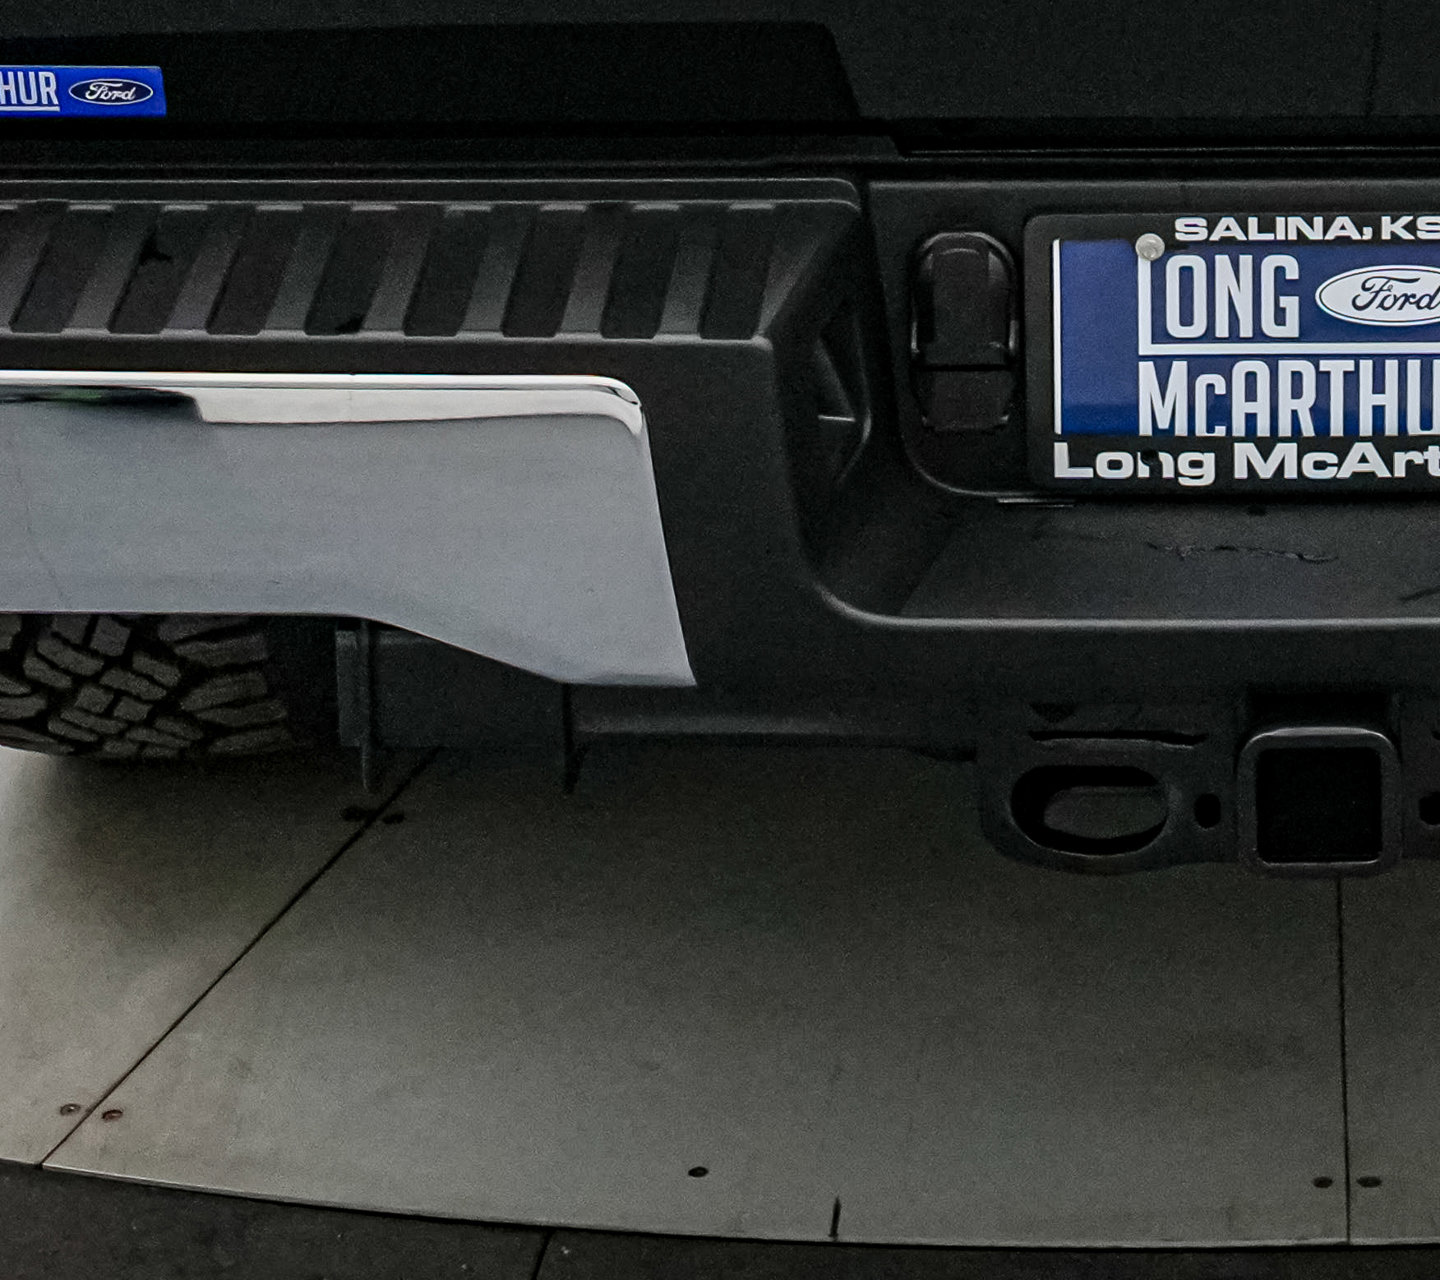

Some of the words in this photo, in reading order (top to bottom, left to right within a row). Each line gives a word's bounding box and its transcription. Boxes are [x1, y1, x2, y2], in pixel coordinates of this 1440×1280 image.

[84, 81, 136, 101] Ford
[1138, 252, 1300, 354] LONG
[1053, 442, 1216, 487] Long
